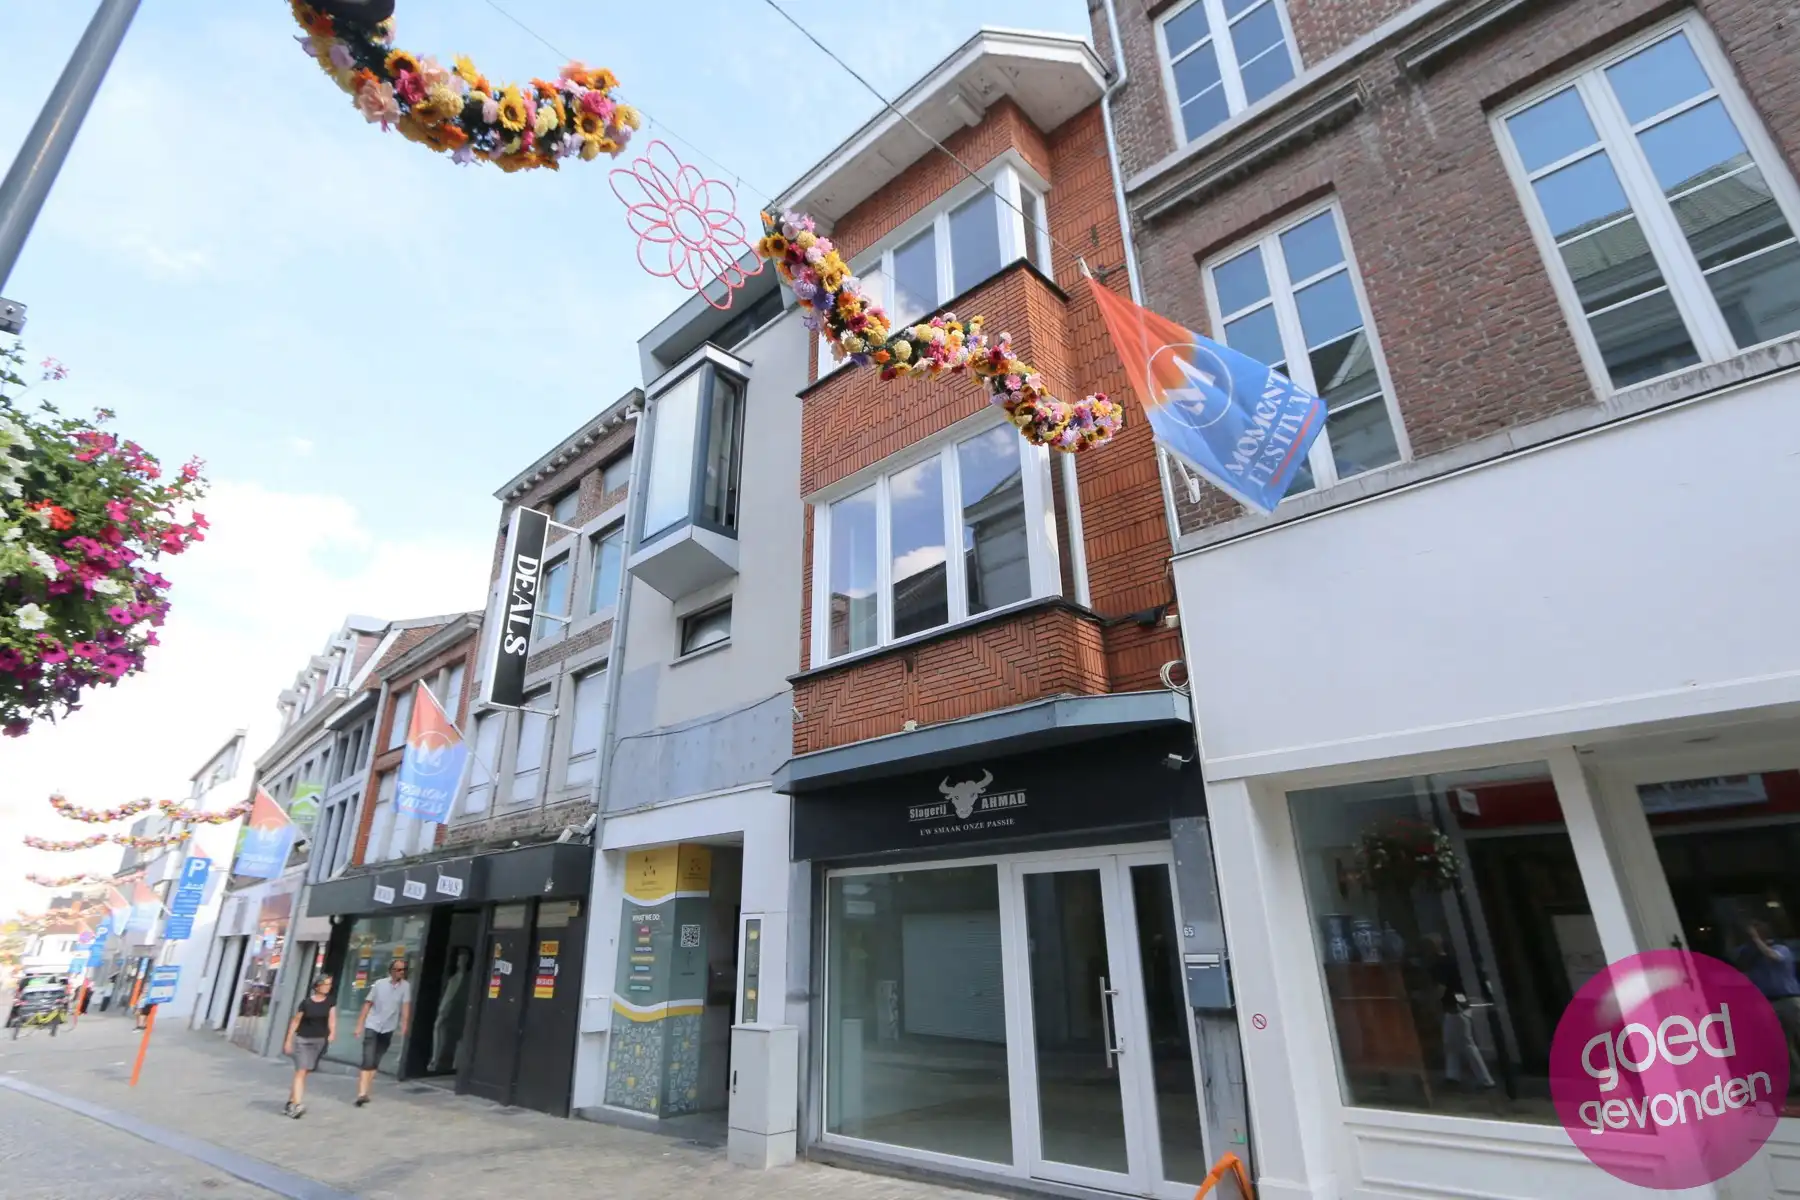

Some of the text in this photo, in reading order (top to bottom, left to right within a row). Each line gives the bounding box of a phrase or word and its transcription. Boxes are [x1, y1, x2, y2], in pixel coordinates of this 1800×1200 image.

[504, 553, 539, 656] DEALS
[909, 792, 1026, 819] Slagerij AHMAD
[934, 825, 961, 834] SMAAK
[963, 821, 985, 831] ONZE
[987, 817, 1015, 828] PASSIE
[188, 859, 206, 877] P
[1183, 927, 1194, 937] 65
